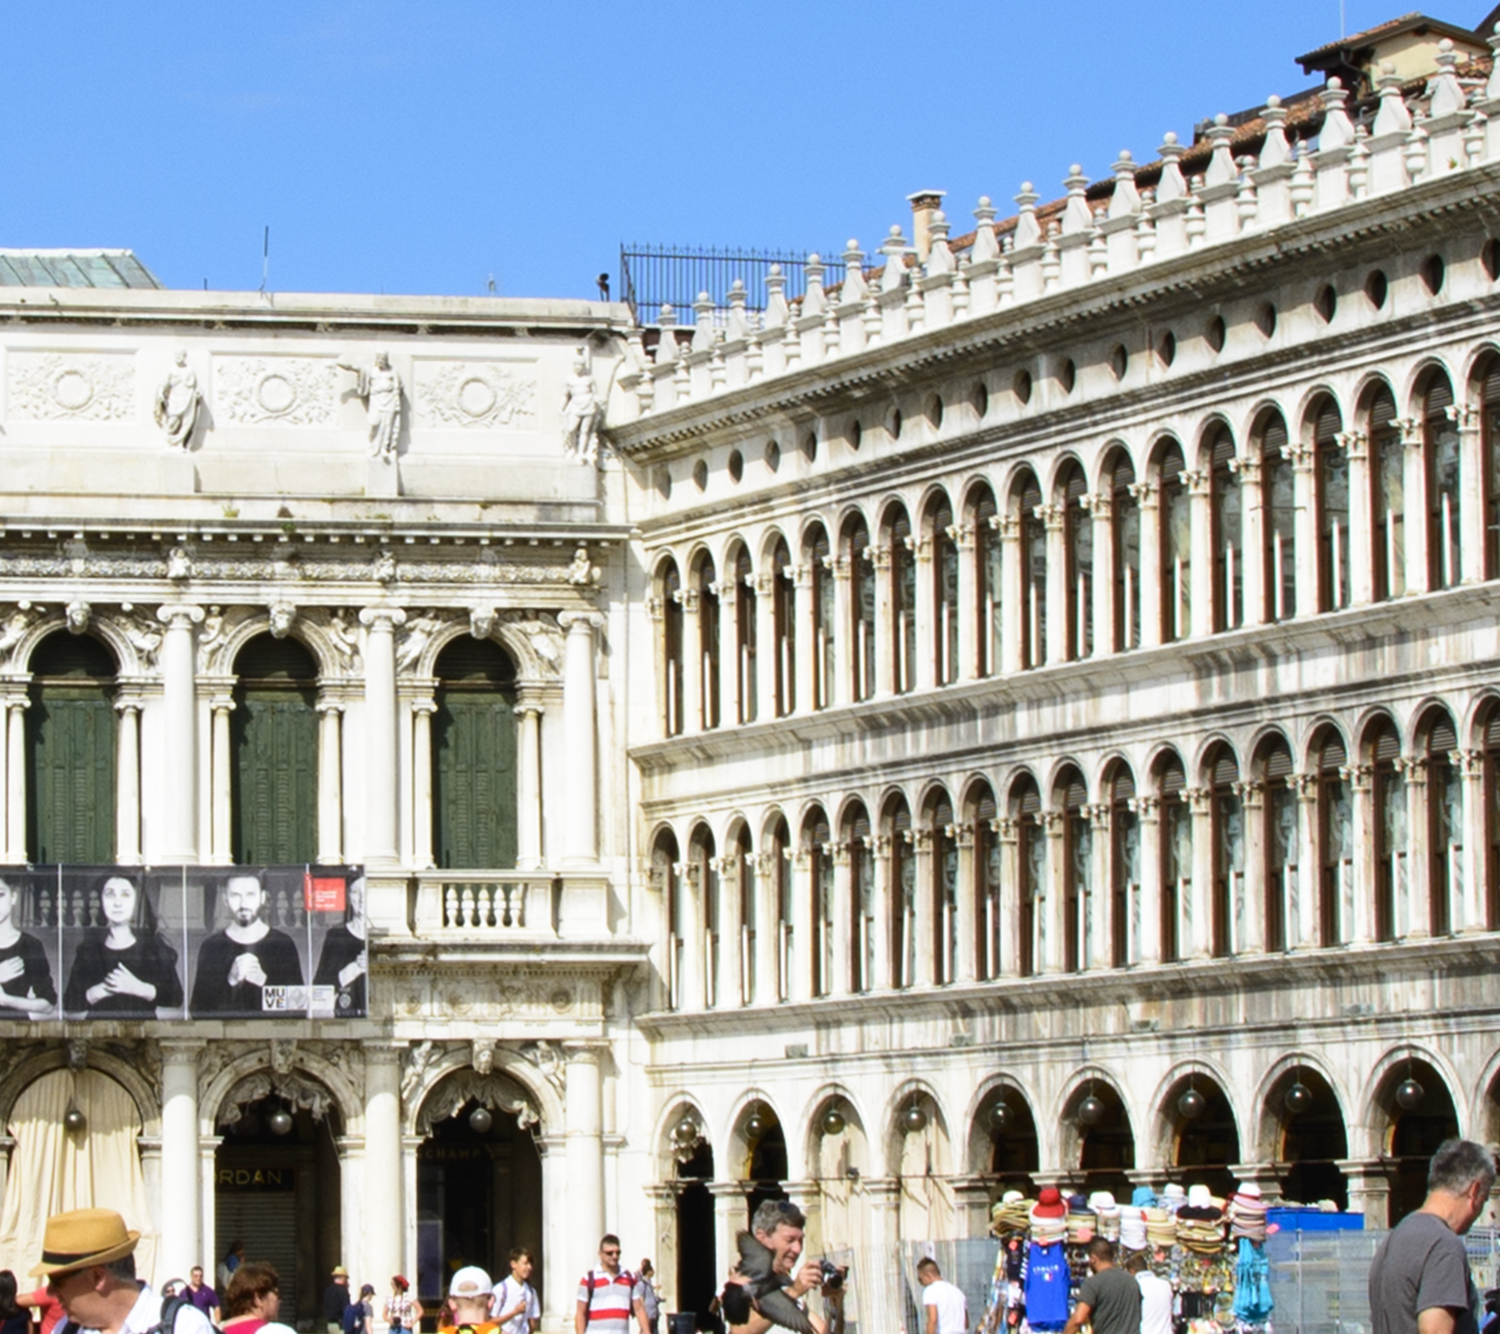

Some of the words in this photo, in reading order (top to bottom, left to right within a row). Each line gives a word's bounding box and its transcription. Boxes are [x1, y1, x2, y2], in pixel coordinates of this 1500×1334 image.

[264, 988, 285, 998] MU
[265, 998, 285, 1008] VE
[215, 1168, 283, 1186] RDAN
